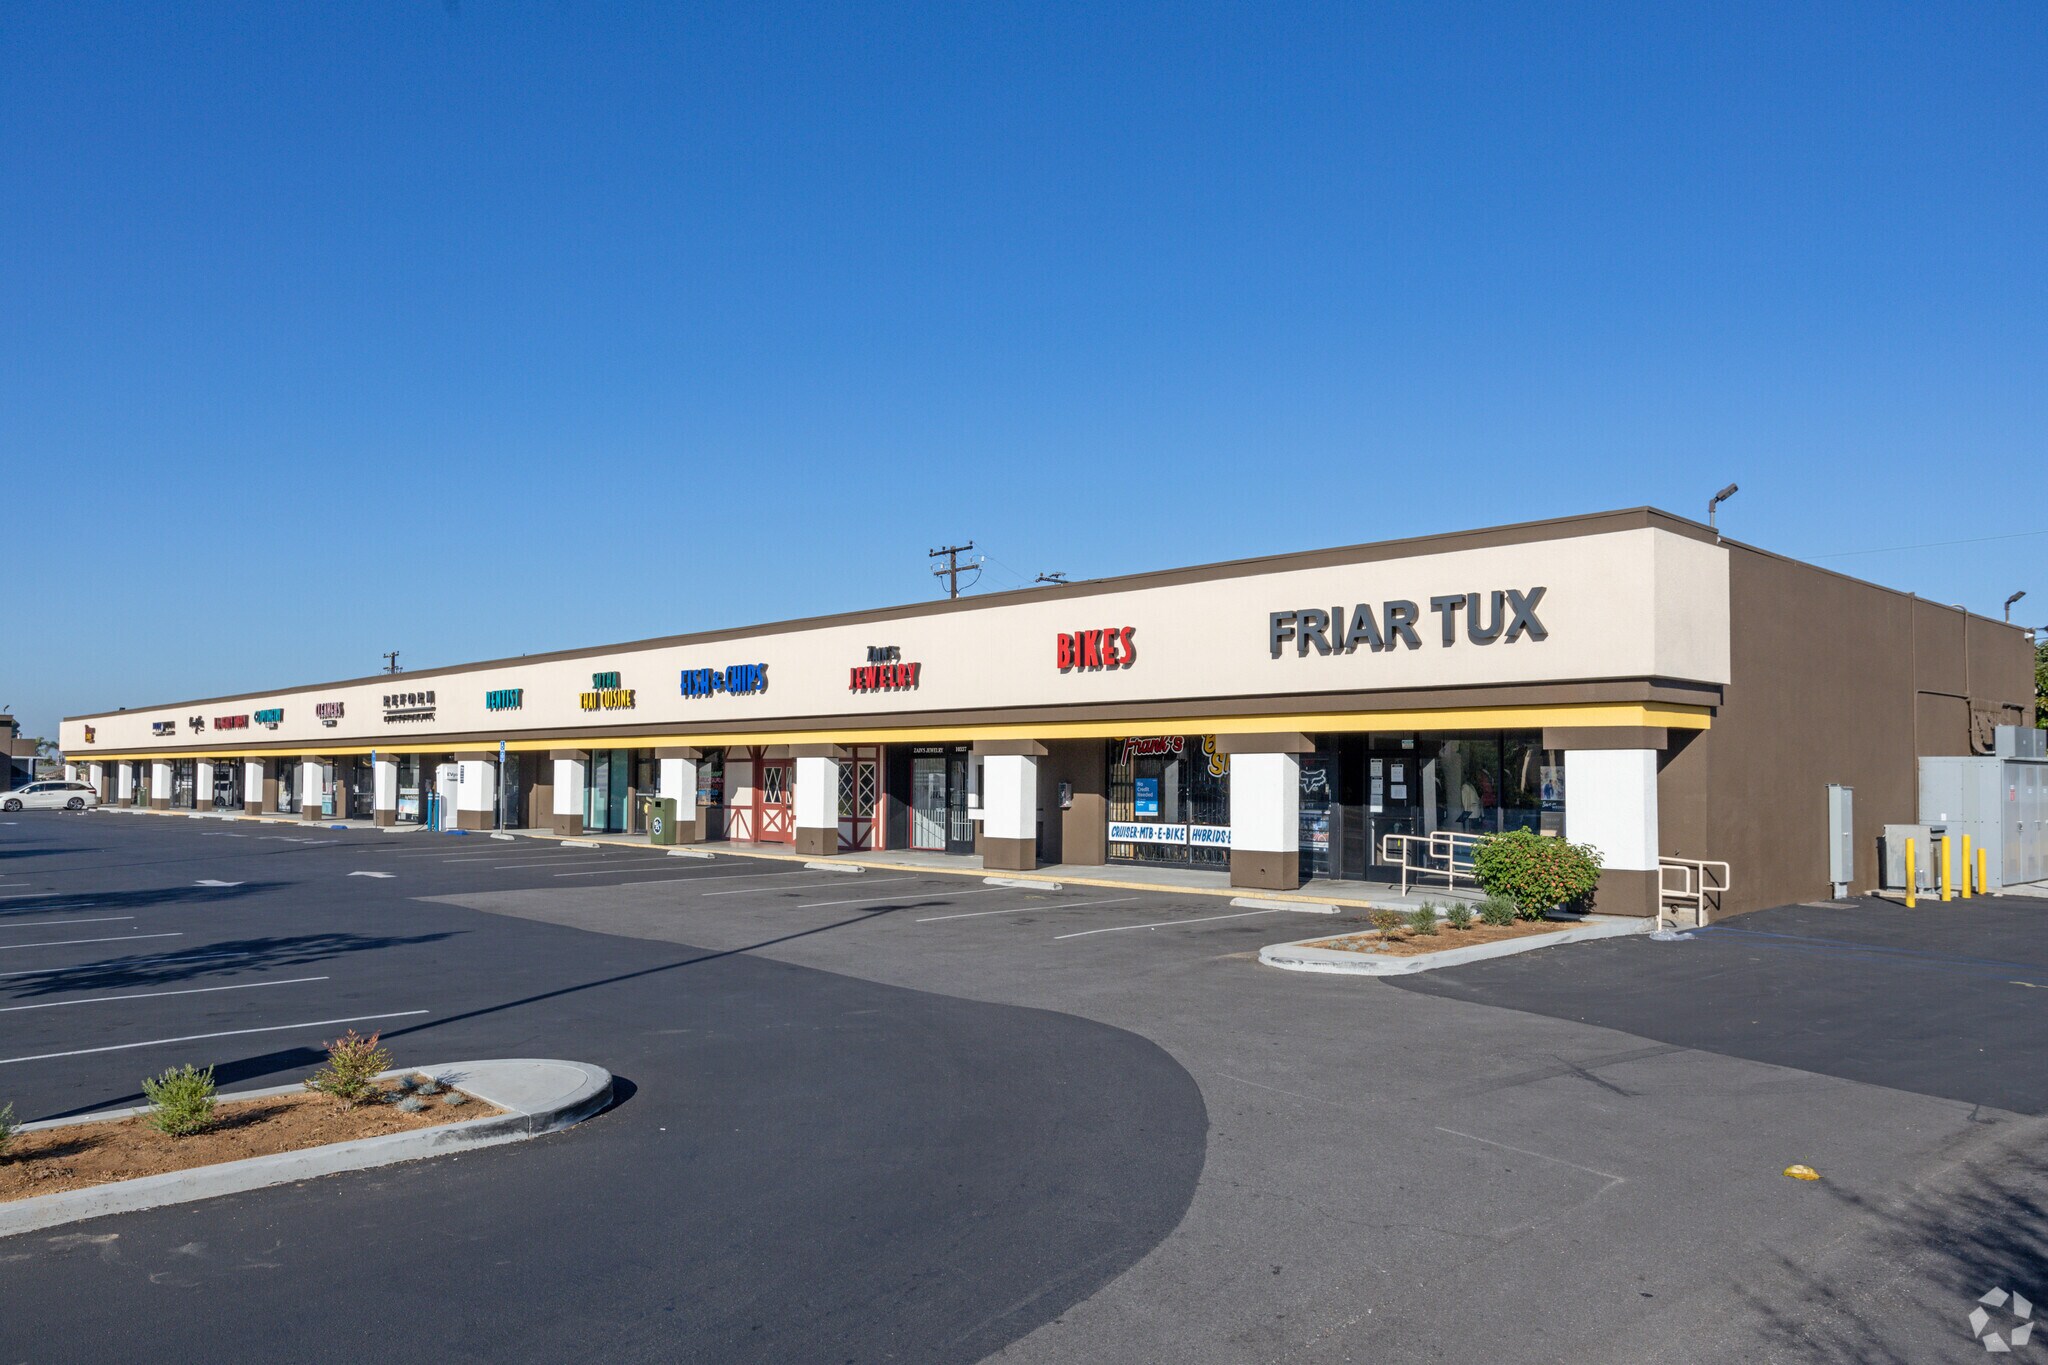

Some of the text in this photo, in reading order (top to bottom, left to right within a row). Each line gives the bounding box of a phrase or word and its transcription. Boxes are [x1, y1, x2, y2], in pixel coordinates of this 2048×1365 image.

[1270, 587, 1548, 658] FRIAR TUX
[1057, 626, 1136, 674] BIKES
[680, 663, 768, 699] FISH & CHIPS
[849, 662, 920, 694] JEWELRY
[486, 688, 523, 712] DENTIST
[579, 689, 636, 712] THAI CUISINE
[1121, 736, 1184, 766] Frank's
